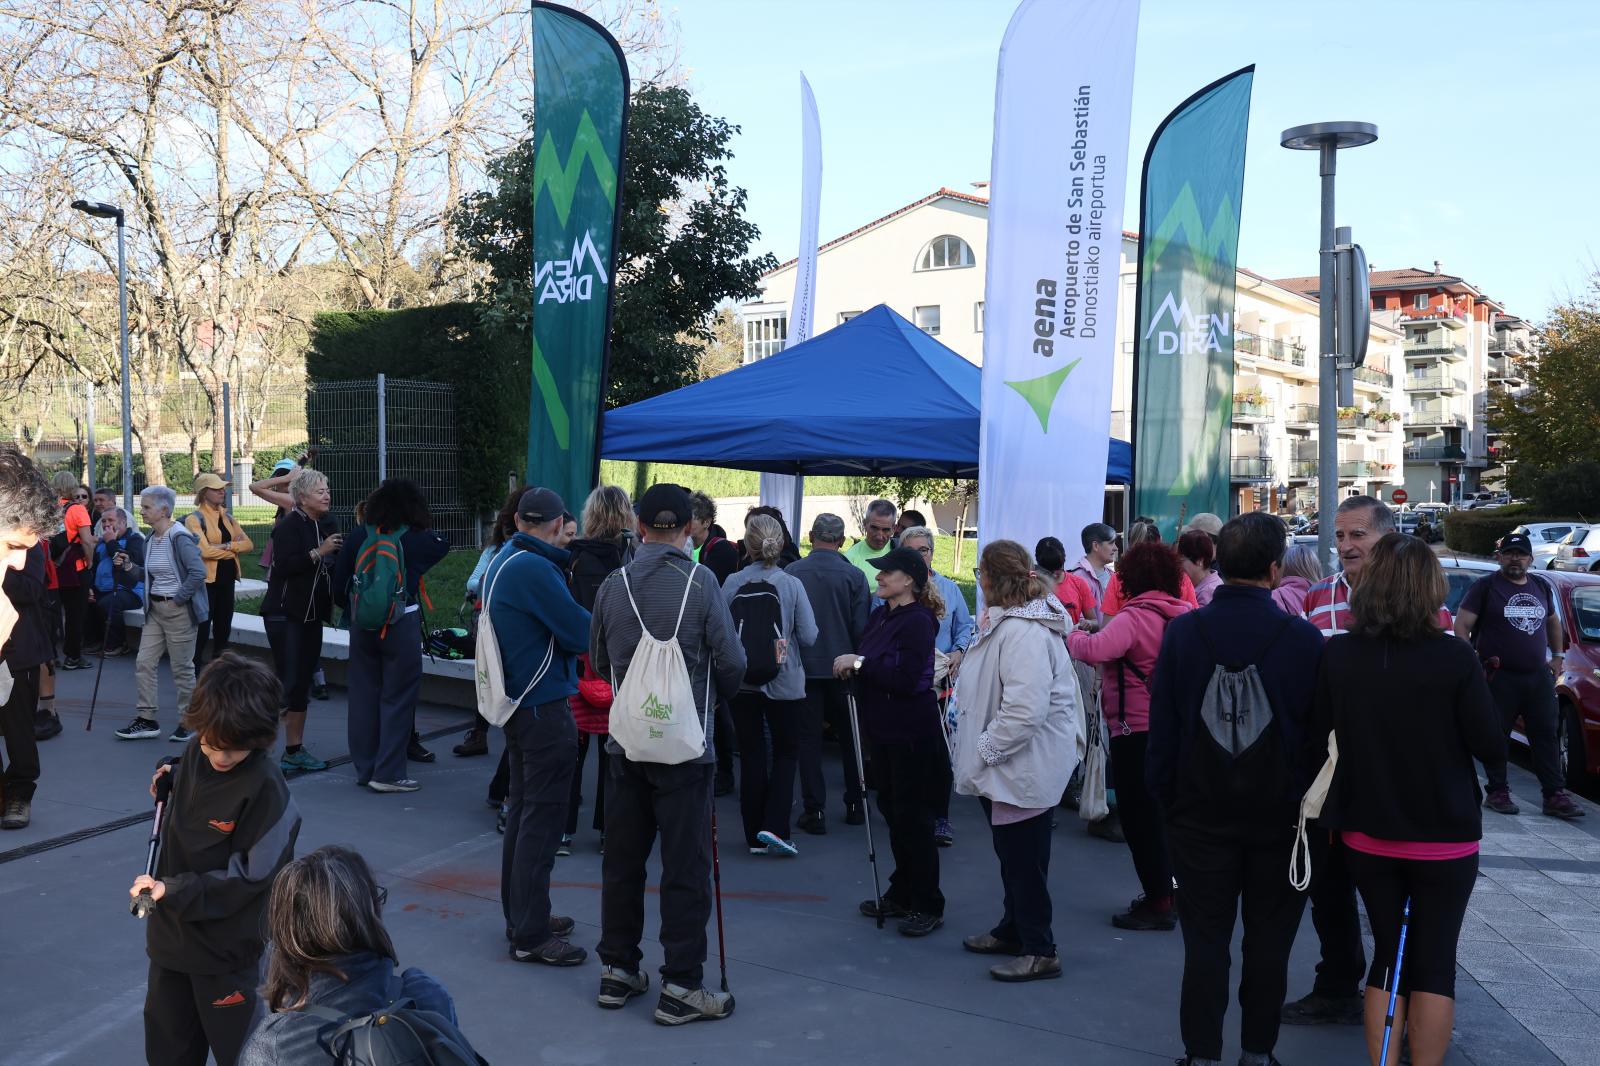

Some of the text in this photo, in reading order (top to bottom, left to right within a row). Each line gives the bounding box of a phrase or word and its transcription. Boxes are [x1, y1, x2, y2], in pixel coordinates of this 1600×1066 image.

[1060, 85, 1091, 338] Aeropuerto de San Sebastián
[1080, 155, 1106, 338] Donostiako aireportua
[1033, 278, 1057, 358] aena
[1145, 290, 1230, 340] MEN
